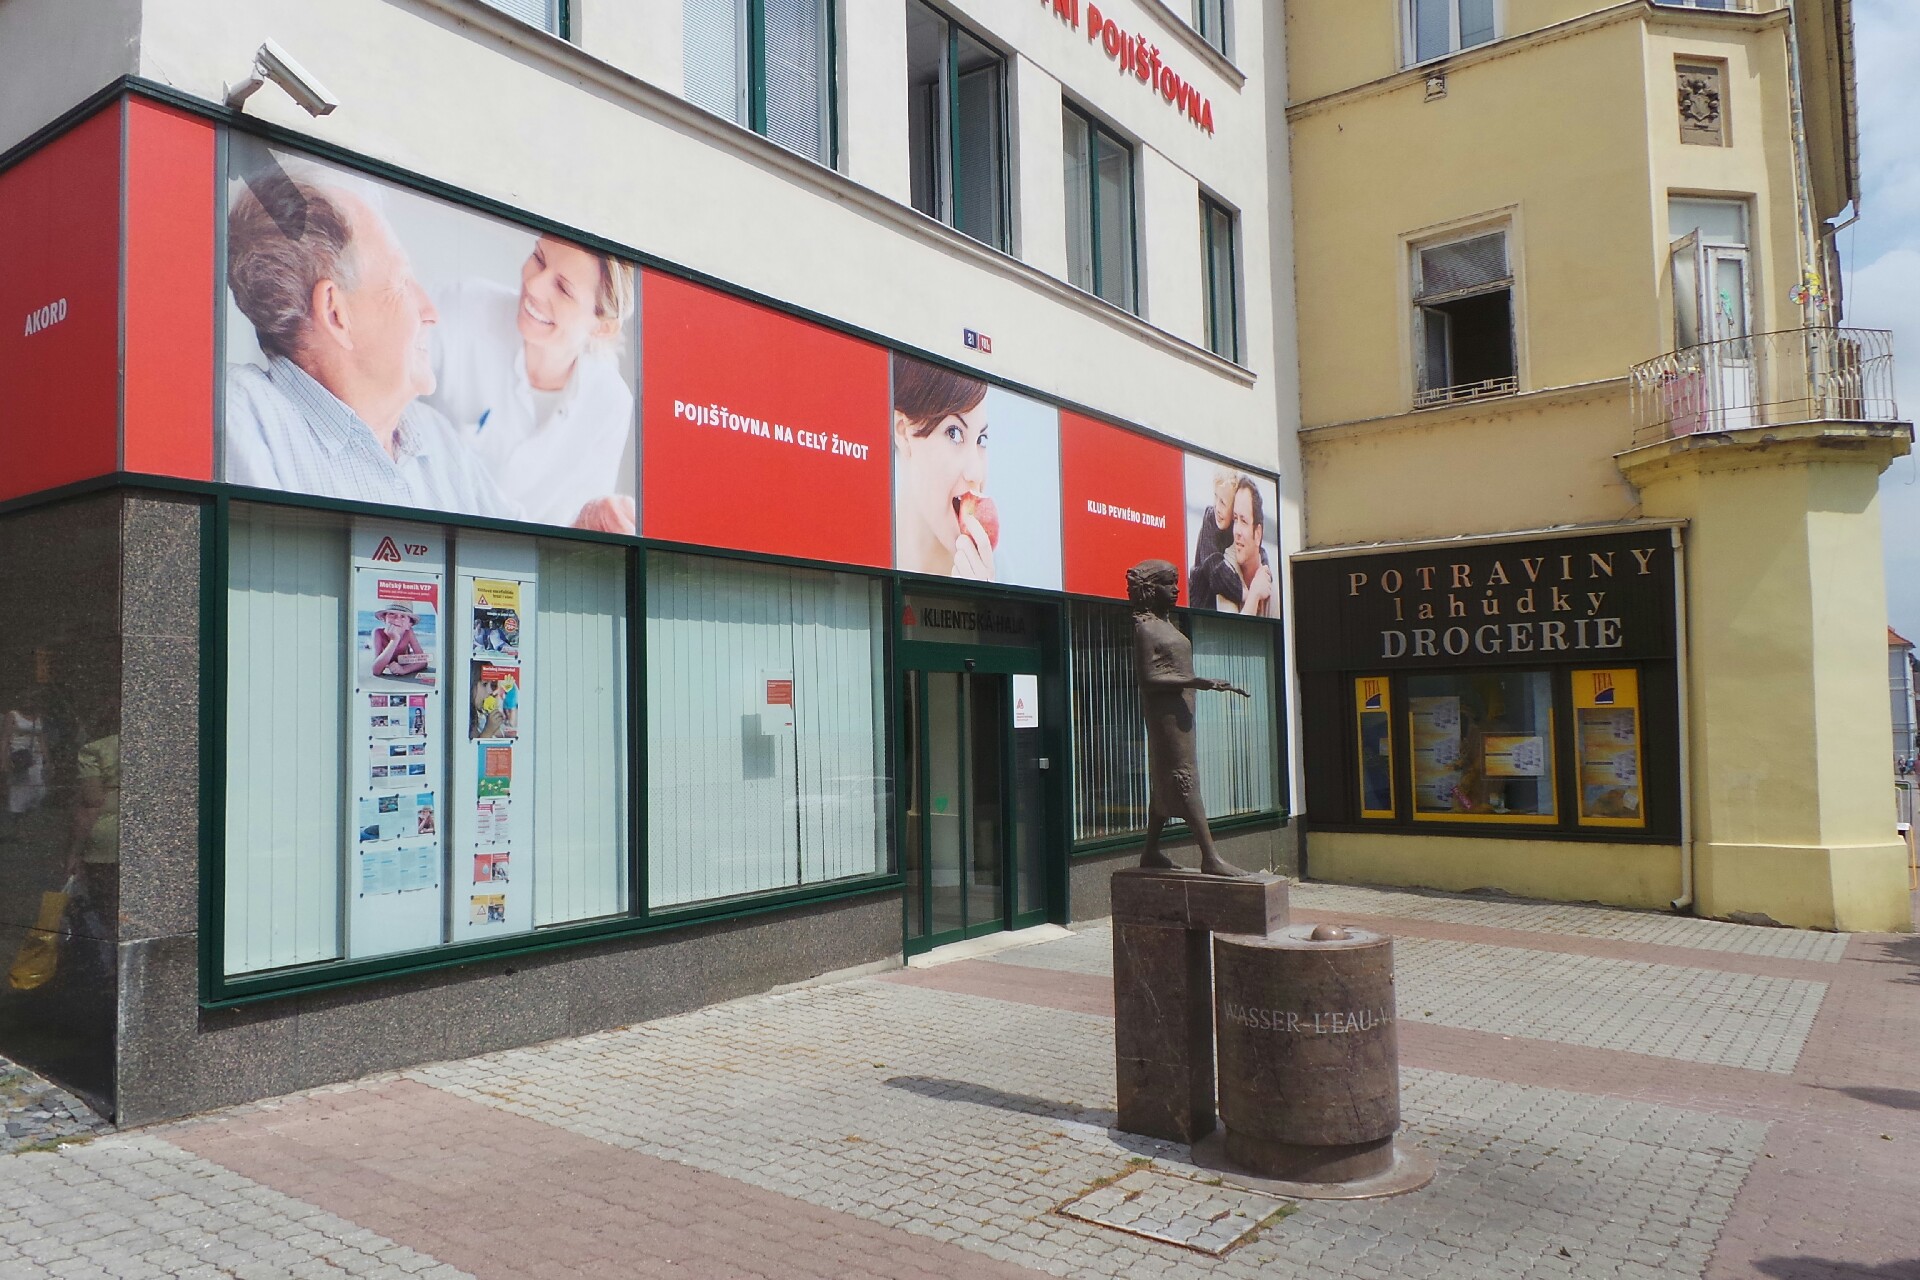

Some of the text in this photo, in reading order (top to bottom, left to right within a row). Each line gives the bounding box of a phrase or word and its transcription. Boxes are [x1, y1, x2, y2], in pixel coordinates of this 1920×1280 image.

[1088, 2, 1215, 134] POJIŠŤOVNA
[24, 298, 67, 336] AKORD
[674, 400, 869, 460] POJIŠŤOVNA NA CELÝ ŽIVOT
[1087, 500, 1166, 529] KLUB PEVNÉHO ZDRAVÍ
[404, 544, 428, 556] VZP
[1348, 548, 1656, 596] POTRAVINY
[923, 607, 994, 633] KLIENTSKÁ
[1381, 617, 1623, 659] DROGERIE
